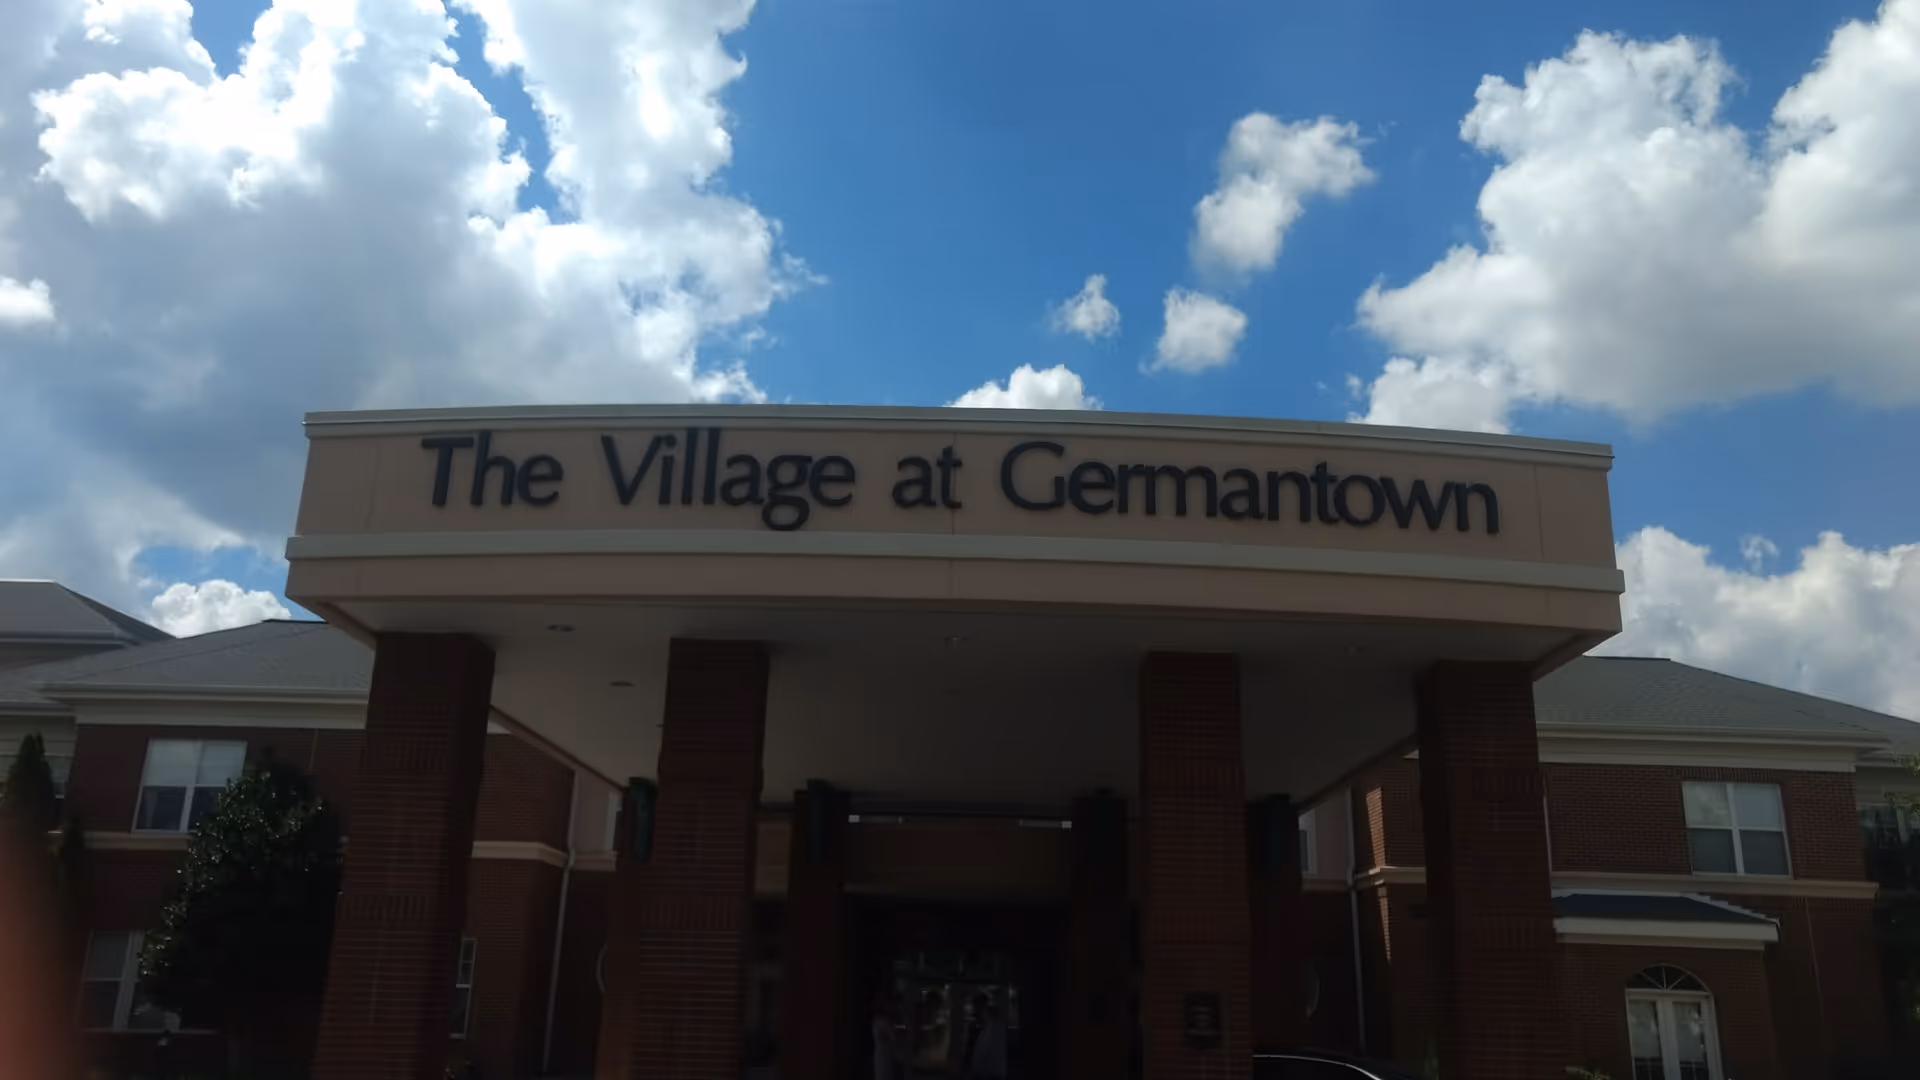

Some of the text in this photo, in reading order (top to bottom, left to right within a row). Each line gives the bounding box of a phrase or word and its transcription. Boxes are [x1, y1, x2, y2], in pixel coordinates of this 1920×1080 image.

[421, 427, 1500, 534] The Village at Germantown
